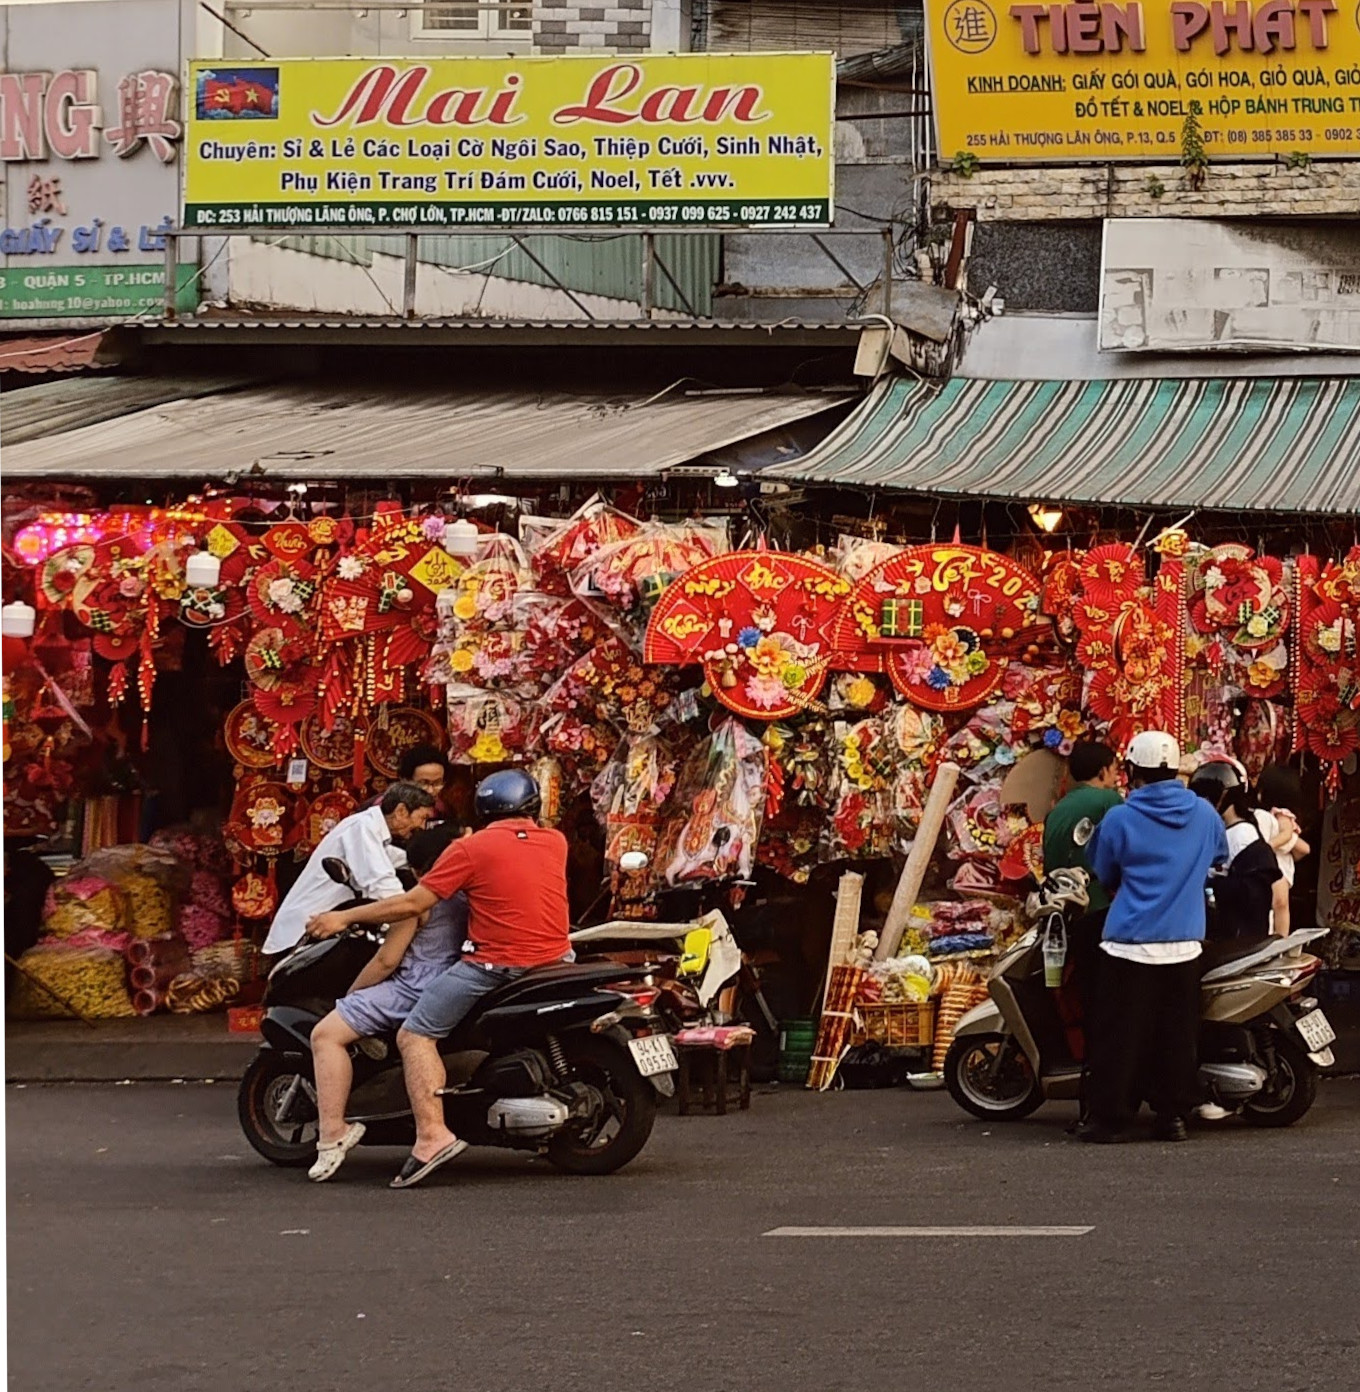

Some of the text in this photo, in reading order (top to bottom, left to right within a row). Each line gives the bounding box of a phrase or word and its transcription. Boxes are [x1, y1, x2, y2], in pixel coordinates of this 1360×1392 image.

[954, 7, 990, 44] 進
[967, 76, 1004, 91] KINH
[1008, 75, 1066, 91] DOANH:
[1072, 67, 1106, 90] GIẤY
[1111, 68, 1139, 90] GÓI
[1143, 68, 1181, 91] QUÀ,
[1185, 67, 1213, 88] GÓI
[1217, 70, 1255, 90] HOA,
[1259, 63, 1287, 87] GIỎ
[1292, 65, 1330, 88] QUÀ,
[313, 64, 769, 126] Mai Lan
[1074, 96, 1098, 118] ĐỒ
[1099, 96, 1130, 117] TẾT
[1132, 100, 1144, 117] &
[1147, 100, 1188, 116] NOEL
[1208, 94, 1241, 118] HỘP
[1245, 93, 1288, 114] BÁNH
[1290, 96, 1345, 113] TRUNG
[199, 135, 821, 162] Chuyên: Sỉ & Lẻ Các Loại Cờ Ngôi Sao, Thiệp Cưới, Sinh Nhật,
[281, 167, 733, 194] Phụ Kiện Trang Trí Đám Cưới, Noel, Tết .vvv.
[0, 218, 63, 255] GIẤY
[109, 225, 130, 253] &
[24, 272, 69, 290] QUẬN
[75, 275, 86, 287] 5
[104, 272, 165, 287] TP.HCM
